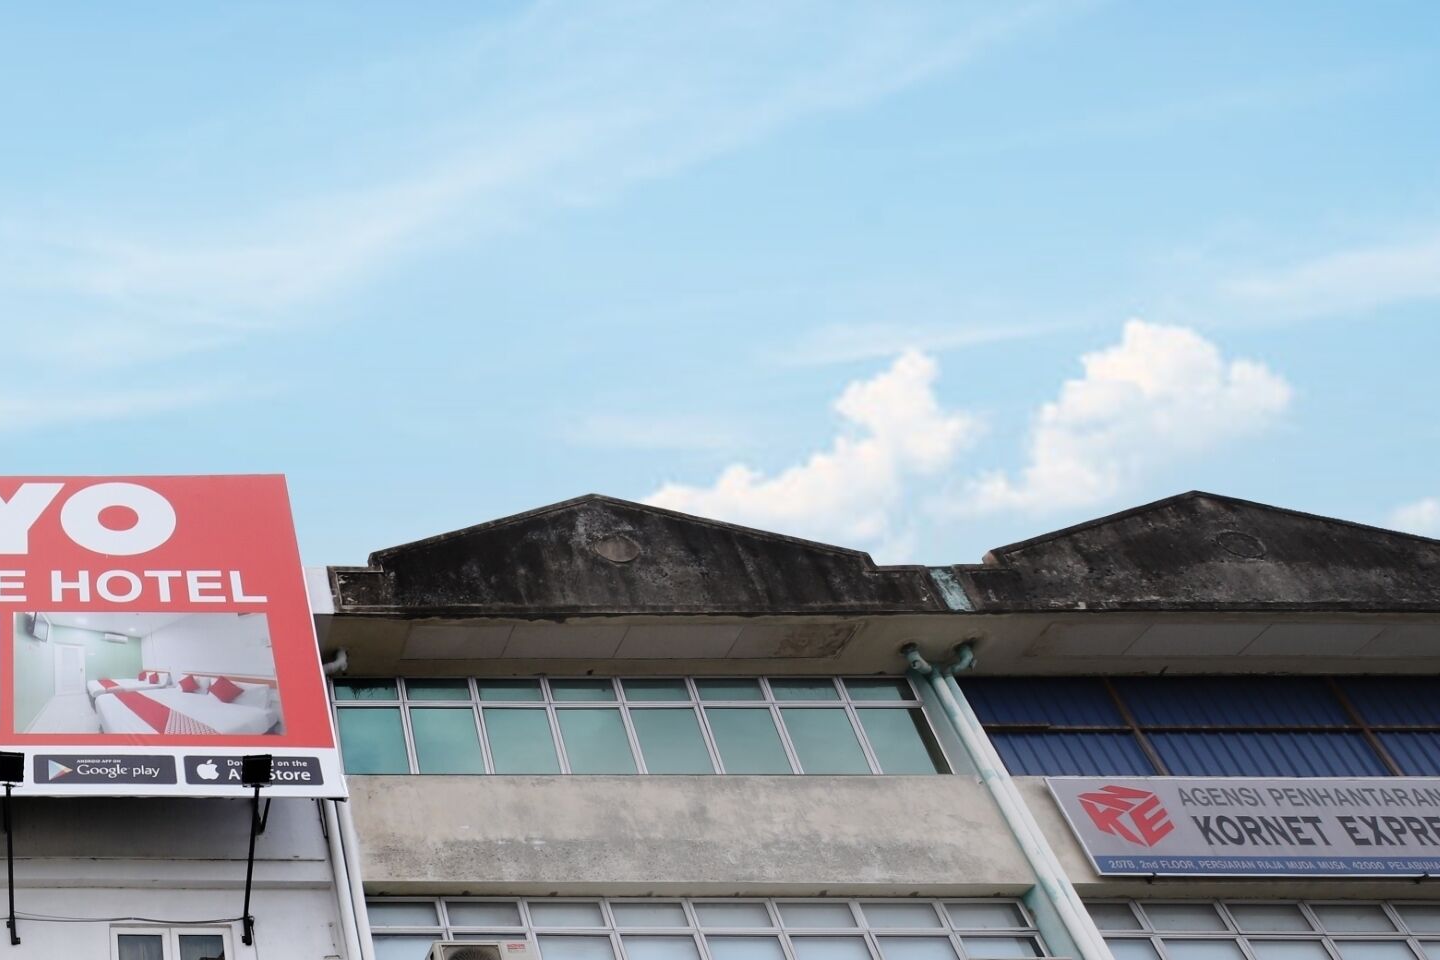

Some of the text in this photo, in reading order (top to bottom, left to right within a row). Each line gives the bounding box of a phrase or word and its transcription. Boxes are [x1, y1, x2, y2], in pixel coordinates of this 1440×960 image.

[50, 569, 268, 603] HOTEL
[76, 764, 161, 778] Google play
[1177, 787, 1262, 808] AGENSI
[1190, 815, 1334, 847] KORNET
